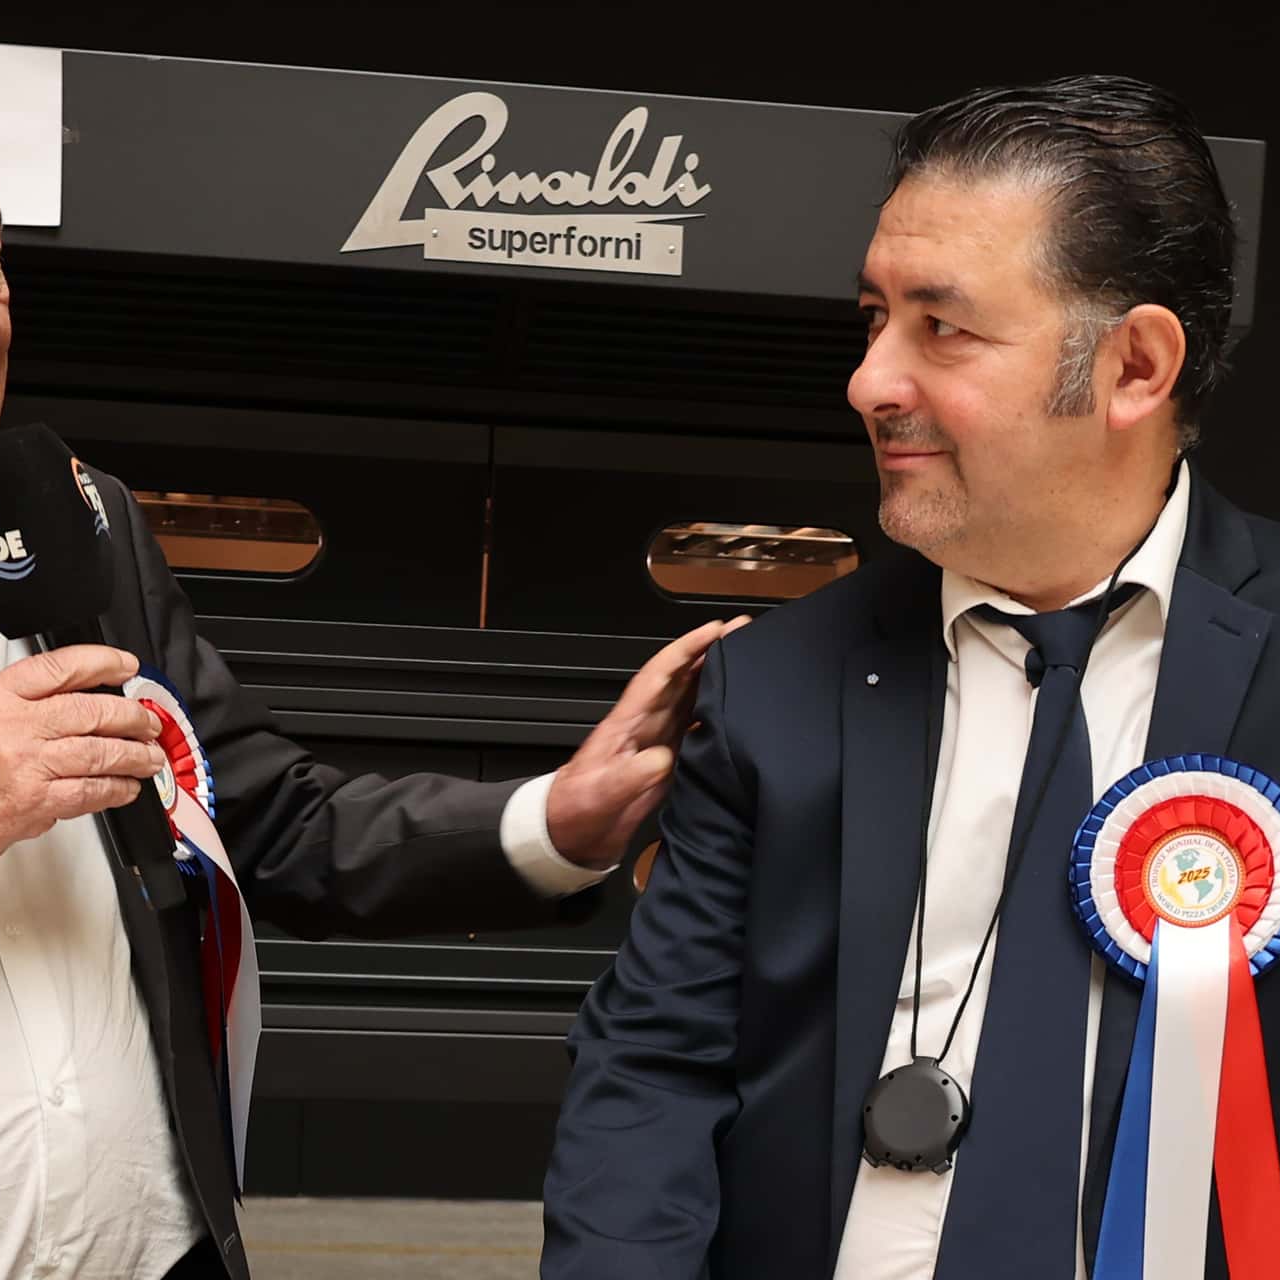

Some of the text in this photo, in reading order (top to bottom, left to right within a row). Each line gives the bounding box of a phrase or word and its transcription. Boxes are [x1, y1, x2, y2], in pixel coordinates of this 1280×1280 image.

[340, 91, 712, 252] Rinaldi
[467, 226, 643, 260] superforni
[1178, 867, 1211, 884] 2025
